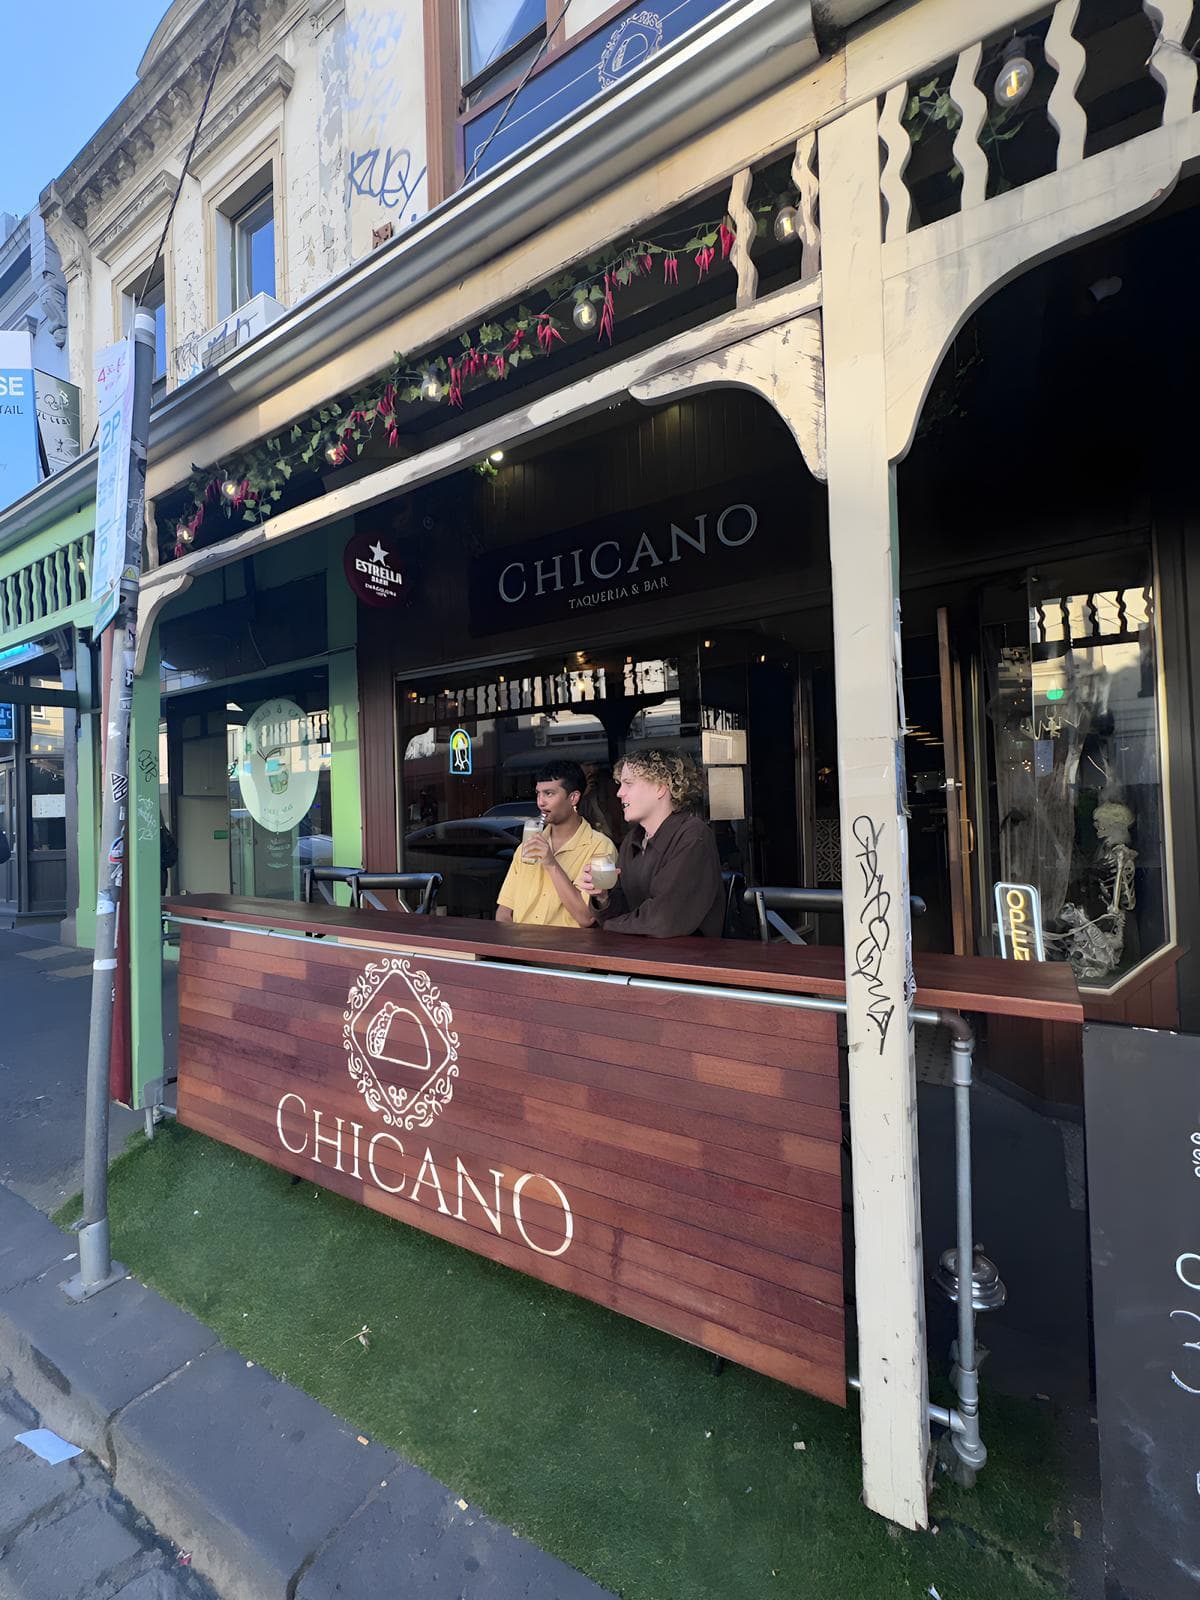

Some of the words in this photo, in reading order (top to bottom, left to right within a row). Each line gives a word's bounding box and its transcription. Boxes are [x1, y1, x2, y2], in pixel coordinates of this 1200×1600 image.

[102, 410, 121, 453] 2P
[355, 558, 402, 584] ESTRELLA
[498, 503, 758, 603] CHICANO
[568, 586, 628, 609] TAQUERIA
[631, 583, 640, 595] &
[643, 576, 669, 592] BAR
[276, 1093, 574, 1257] CHICANO
